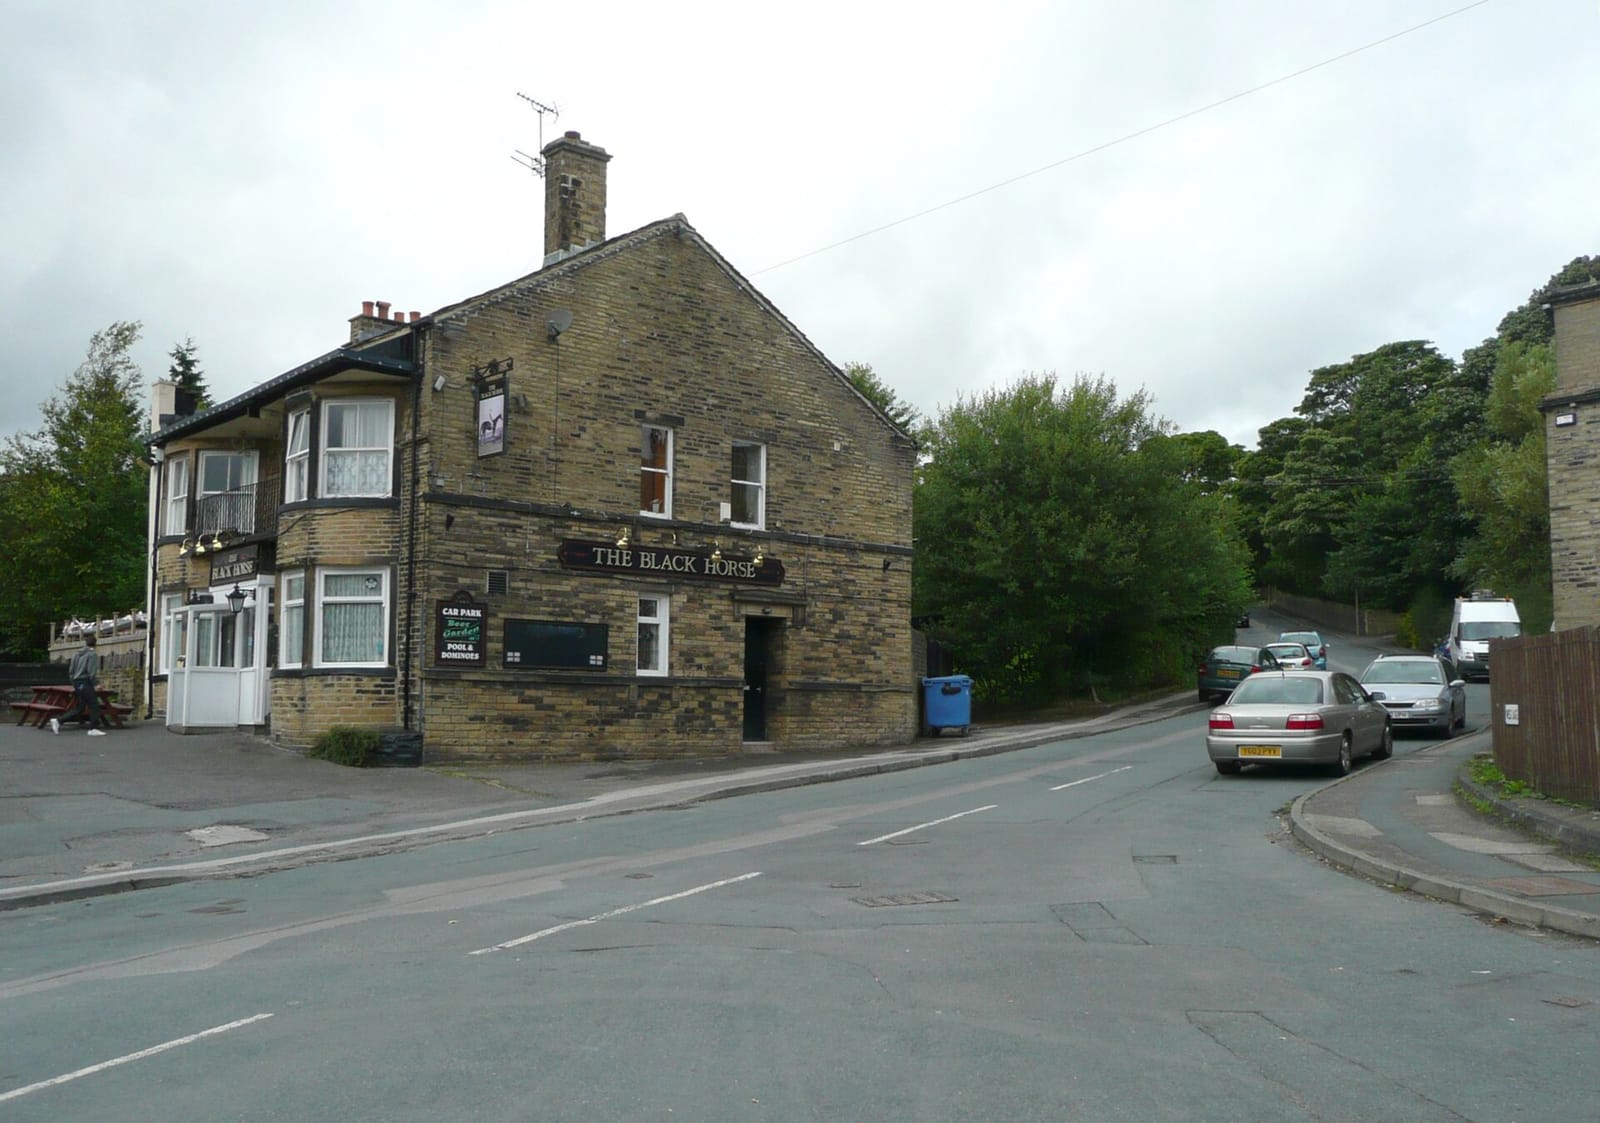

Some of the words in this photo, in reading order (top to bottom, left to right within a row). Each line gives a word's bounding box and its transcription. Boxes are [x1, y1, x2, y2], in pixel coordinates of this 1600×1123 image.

[592, 547, 632, 567] THE
[639, 551, 696, 573] BLACK
[704, 557, 756, 578] HORSE
[442, 607, 459, 616] CAR
[460, 608, 482, 617] PARK
[442, 626, 480, 638] Garden
[447, 643, 467, 651] POOL
[441, 652, 480, 660] DOMINOES
